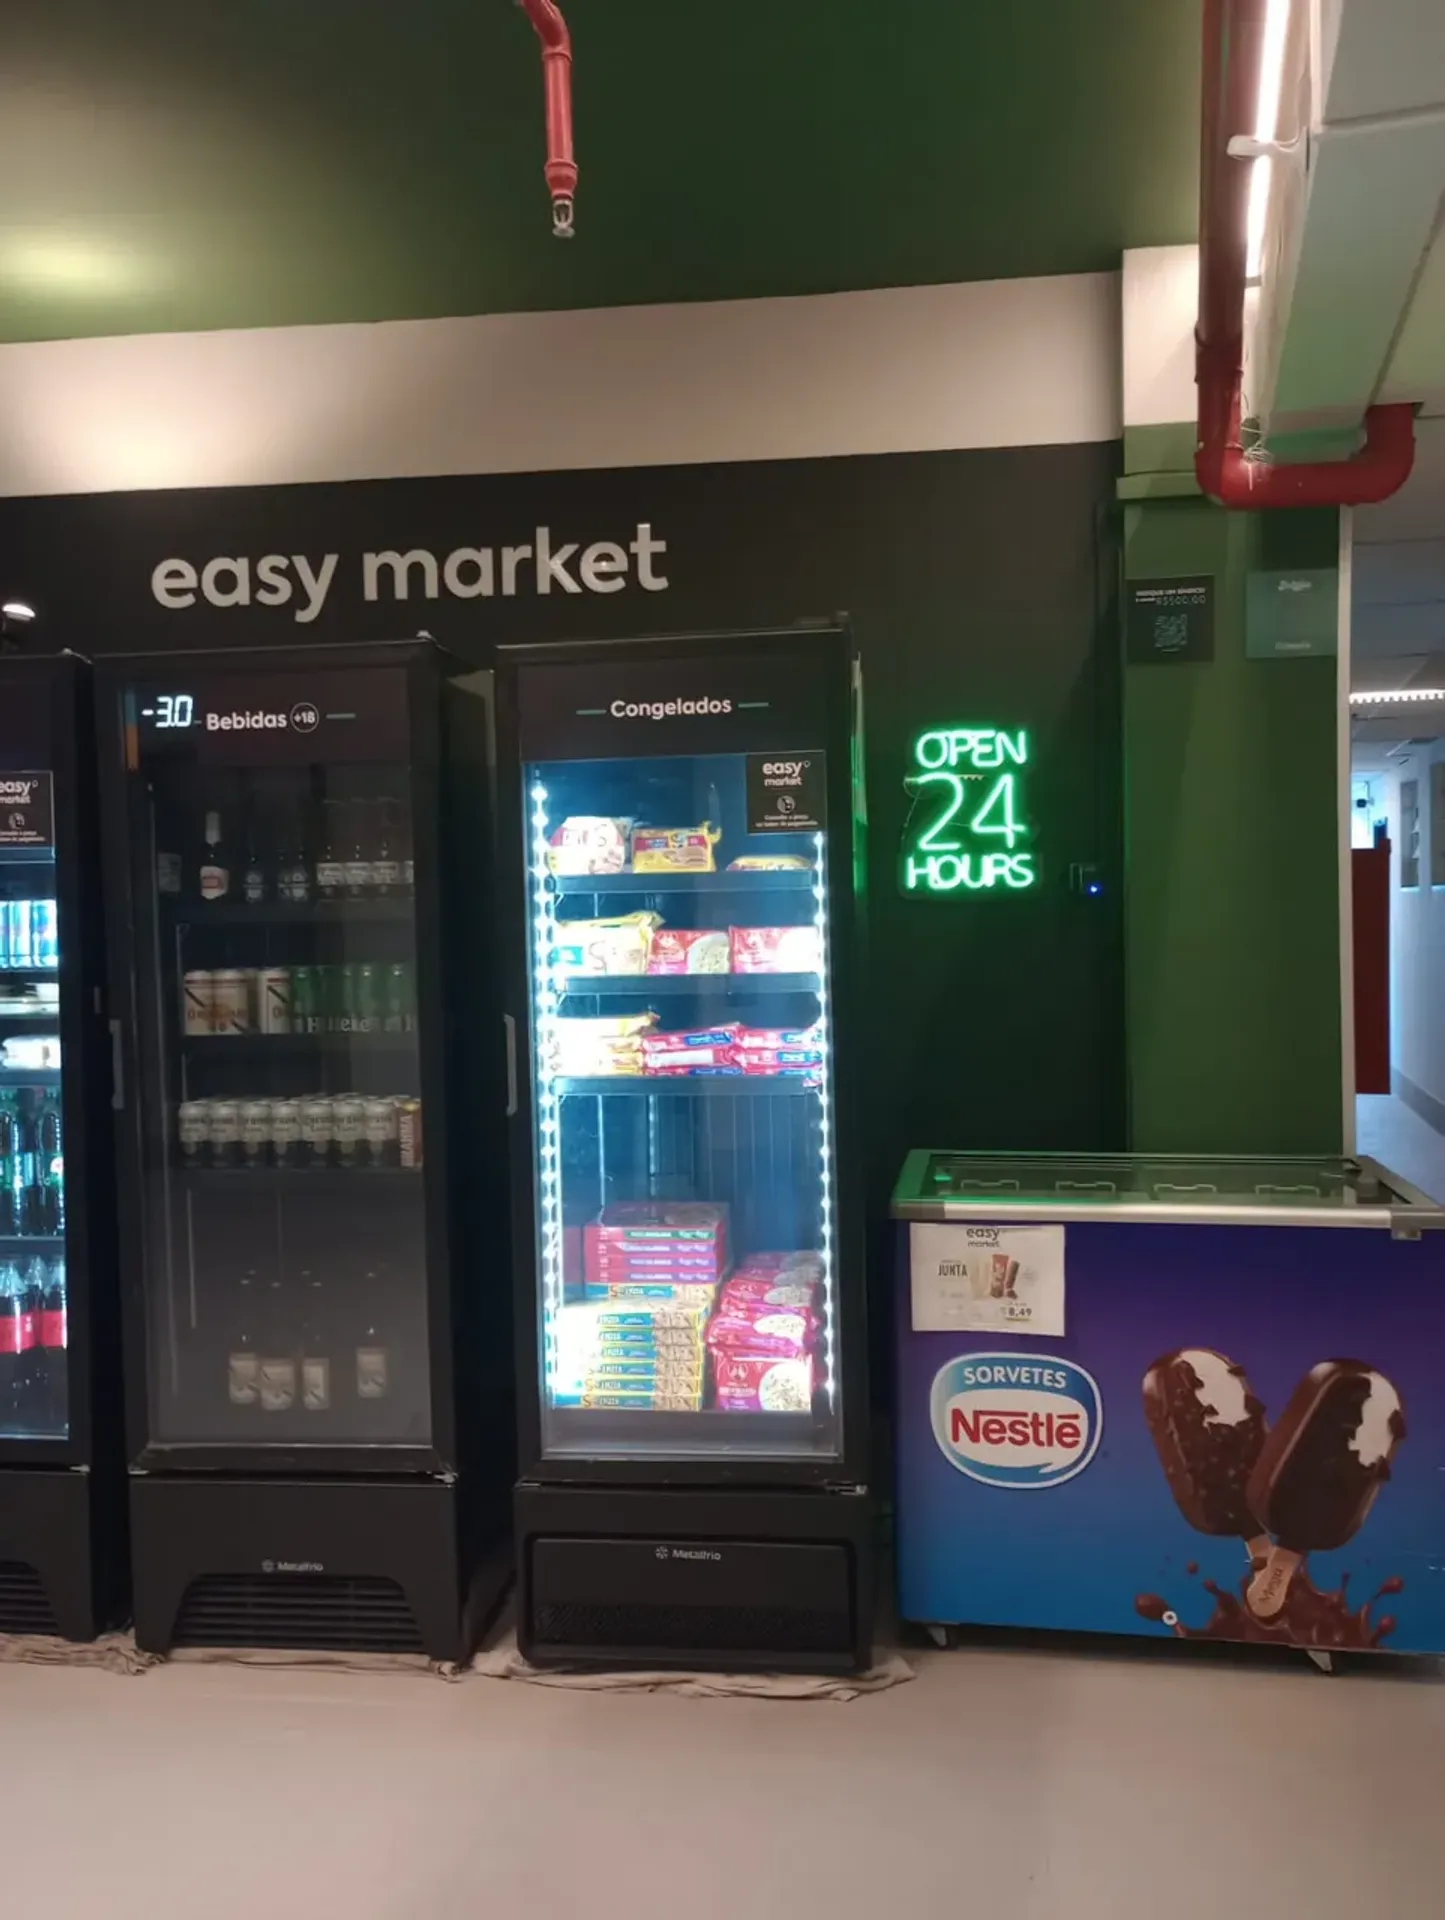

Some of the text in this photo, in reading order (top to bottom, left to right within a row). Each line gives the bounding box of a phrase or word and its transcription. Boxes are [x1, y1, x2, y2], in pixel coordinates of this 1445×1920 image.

[151, 522, 669, 623] easy market
[141, 694, 194, 728] -3.0
[610, 696, 732, 720] Congelados
[206, 710, 316, 731] Bebidas +18
[915, 729, 1028, 769] OPEN
[762, 761, 803, 777] easy
[764, 776, 803, 788] market
[917, 771, 1028, 851] 24
[905, 852, 1035, 890] HOURS
[966, 1227, 1001, 1241] easy
[967, 1239, 1001, 1248] market
[938, 1263, 969, 1277] JUNTA
[963, 1365, 1067, 1389] SORVETES
[950, 1407, 1082, 1449] Nestlé
